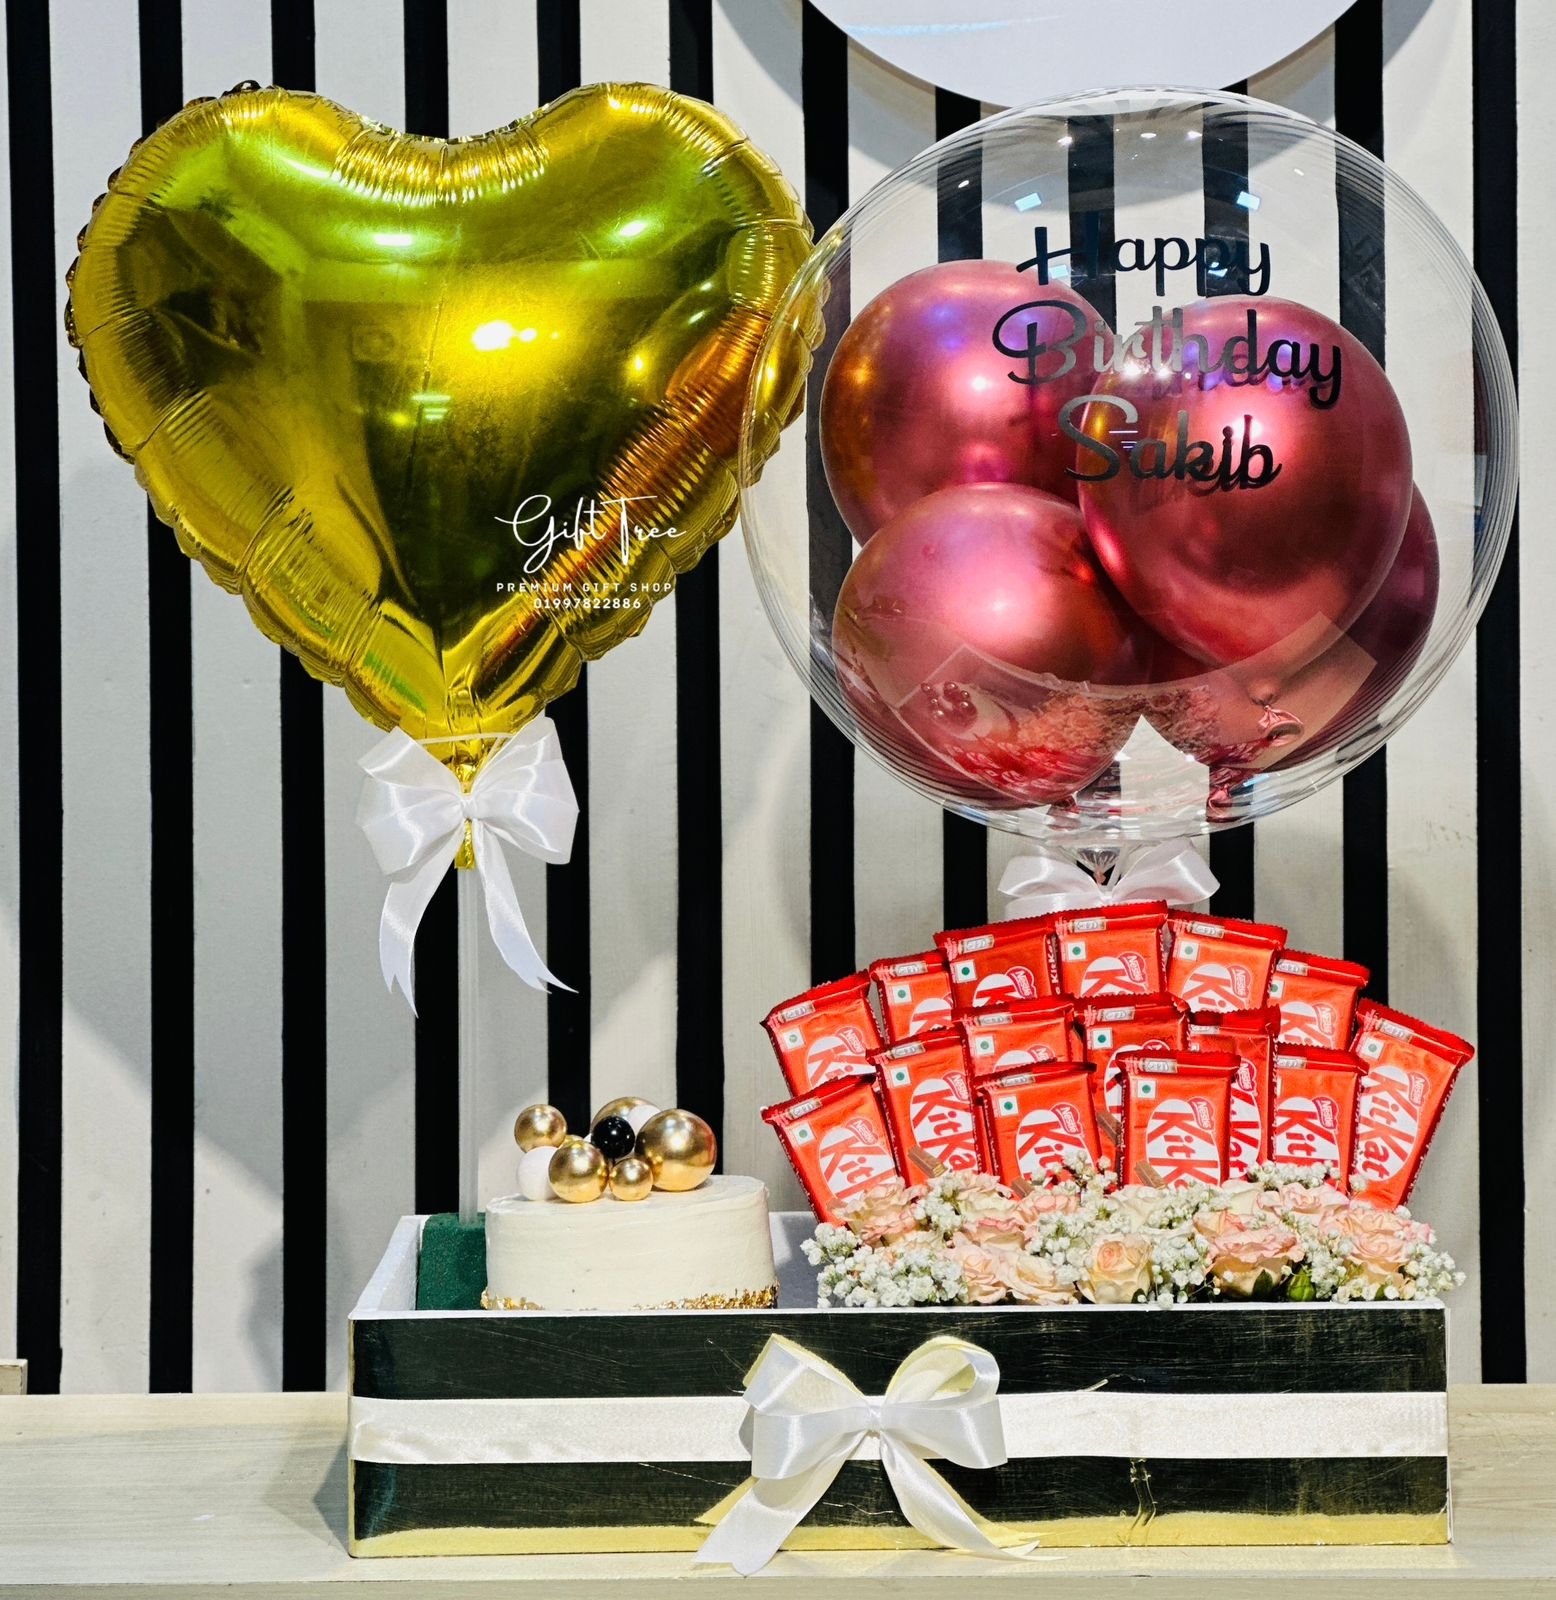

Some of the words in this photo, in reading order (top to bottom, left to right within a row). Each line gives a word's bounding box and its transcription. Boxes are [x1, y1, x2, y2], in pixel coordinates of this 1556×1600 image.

[1016, 226, 1271, 298] Happy
[992, 300, 1342, 409] Birthday
[1058, 394, 1283, 490] Sakib
[912, 1089, 977, 1172] KitKa
[1358, 1071, 1418, 1179] KitKat
